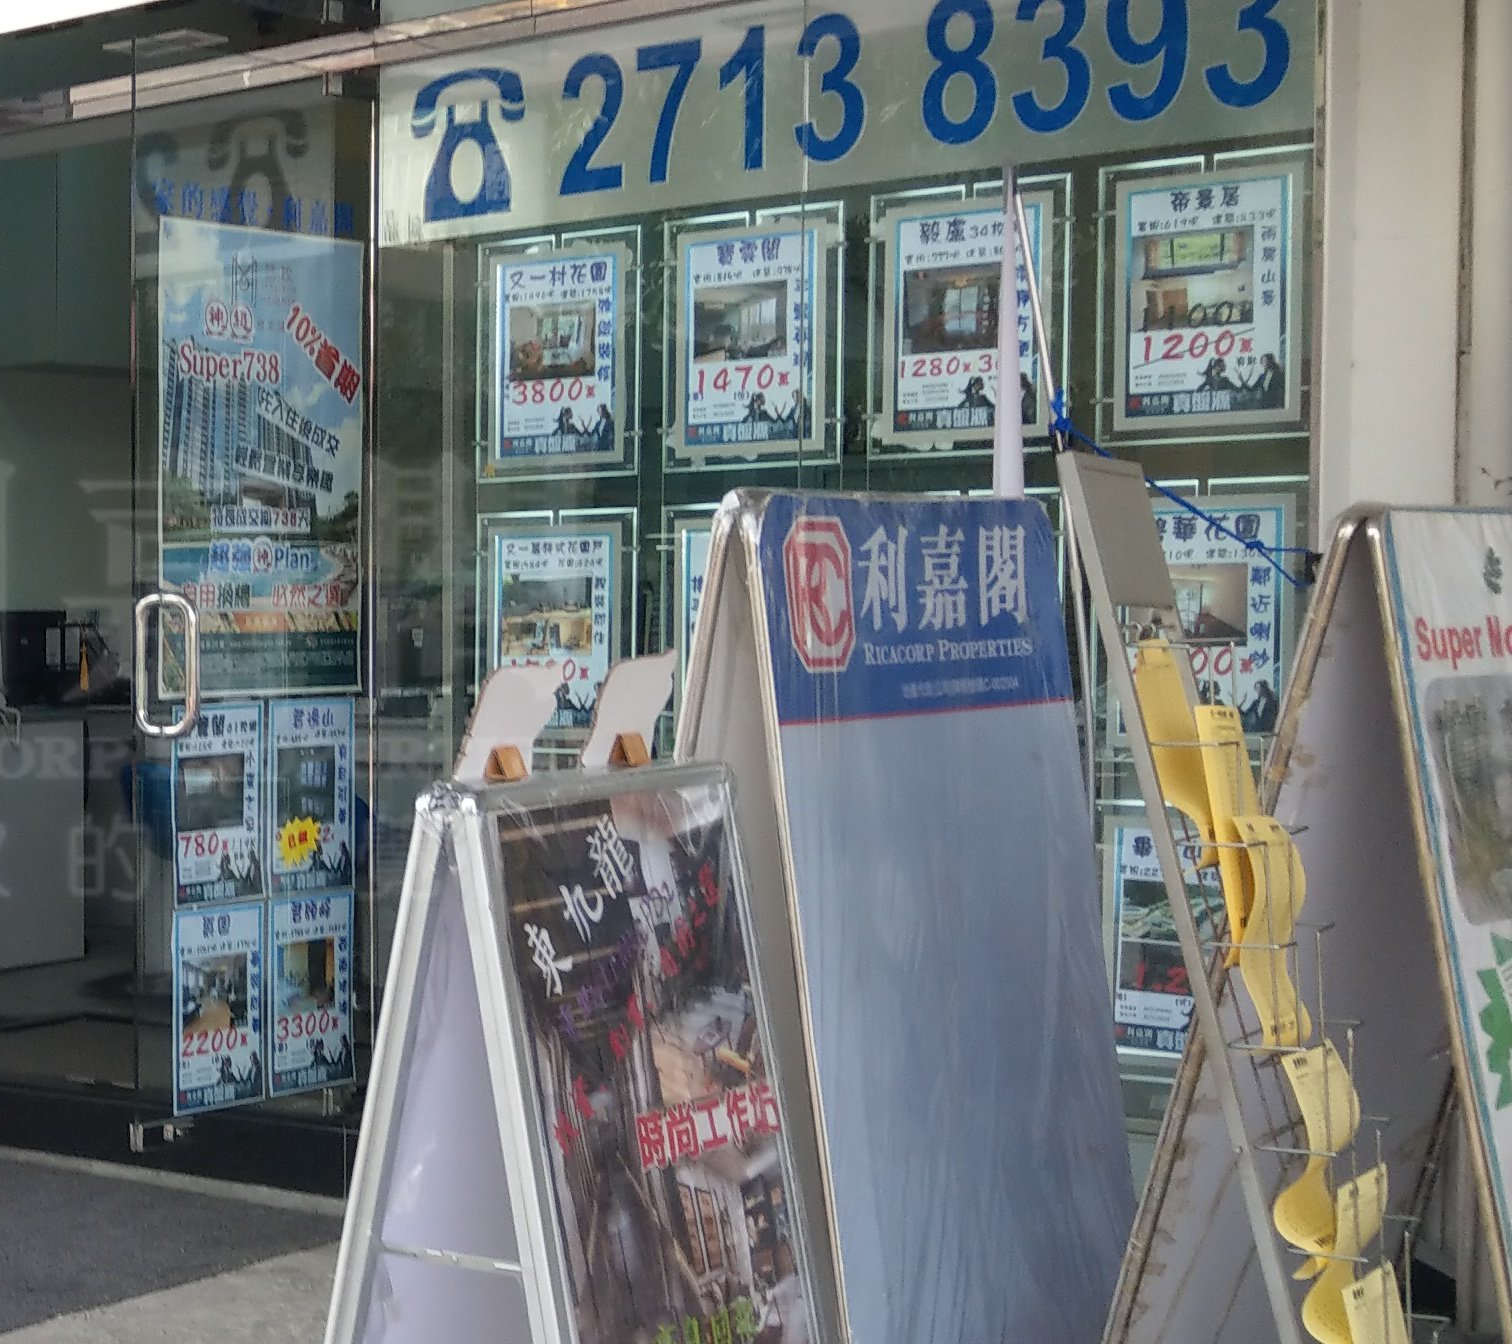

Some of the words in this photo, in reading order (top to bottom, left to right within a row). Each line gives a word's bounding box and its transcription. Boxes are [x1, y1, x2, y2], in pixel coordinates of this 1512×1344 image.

[559, 13, 865, 197] 2713
[509, 261, 609, 292] 又一村花園
[179, 340, 281, 385] Super738
[857, 522, 1031, 634] 利嘉閣
[863, 641, 935, 667] RICACORP
[938, 636, 1034, 663] PROPERTIES
[1414, 616, 1484, 671] Super
[635, 1082, 781, 1171] 時尚工作站
